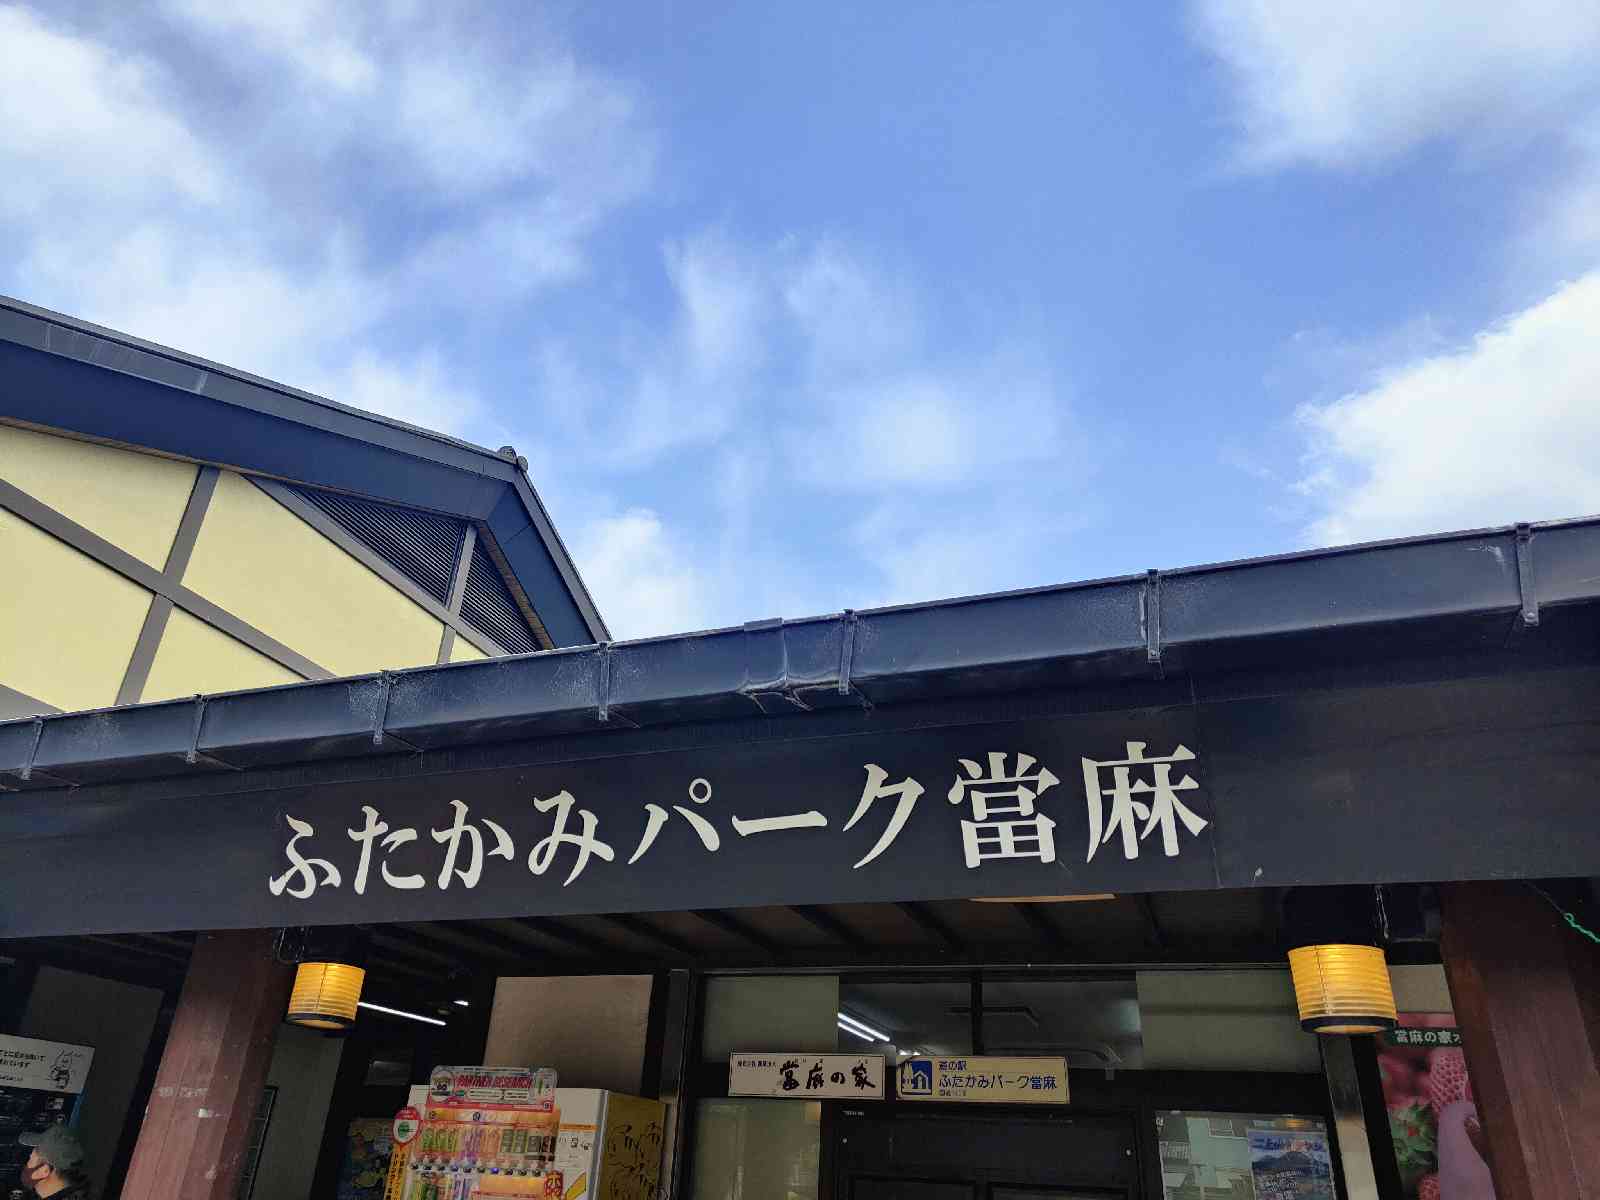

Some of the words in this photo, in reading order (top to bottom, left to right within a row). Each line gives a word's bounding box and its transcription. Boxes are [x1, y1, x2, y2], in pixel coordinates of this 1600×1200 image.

[270, 742, 1208, 898] ふたかみパーク當麻
[938, 1060, 967, 1072] 道の駅
[938, 1073, 1057, 1090] ふたかみパーク當麻
